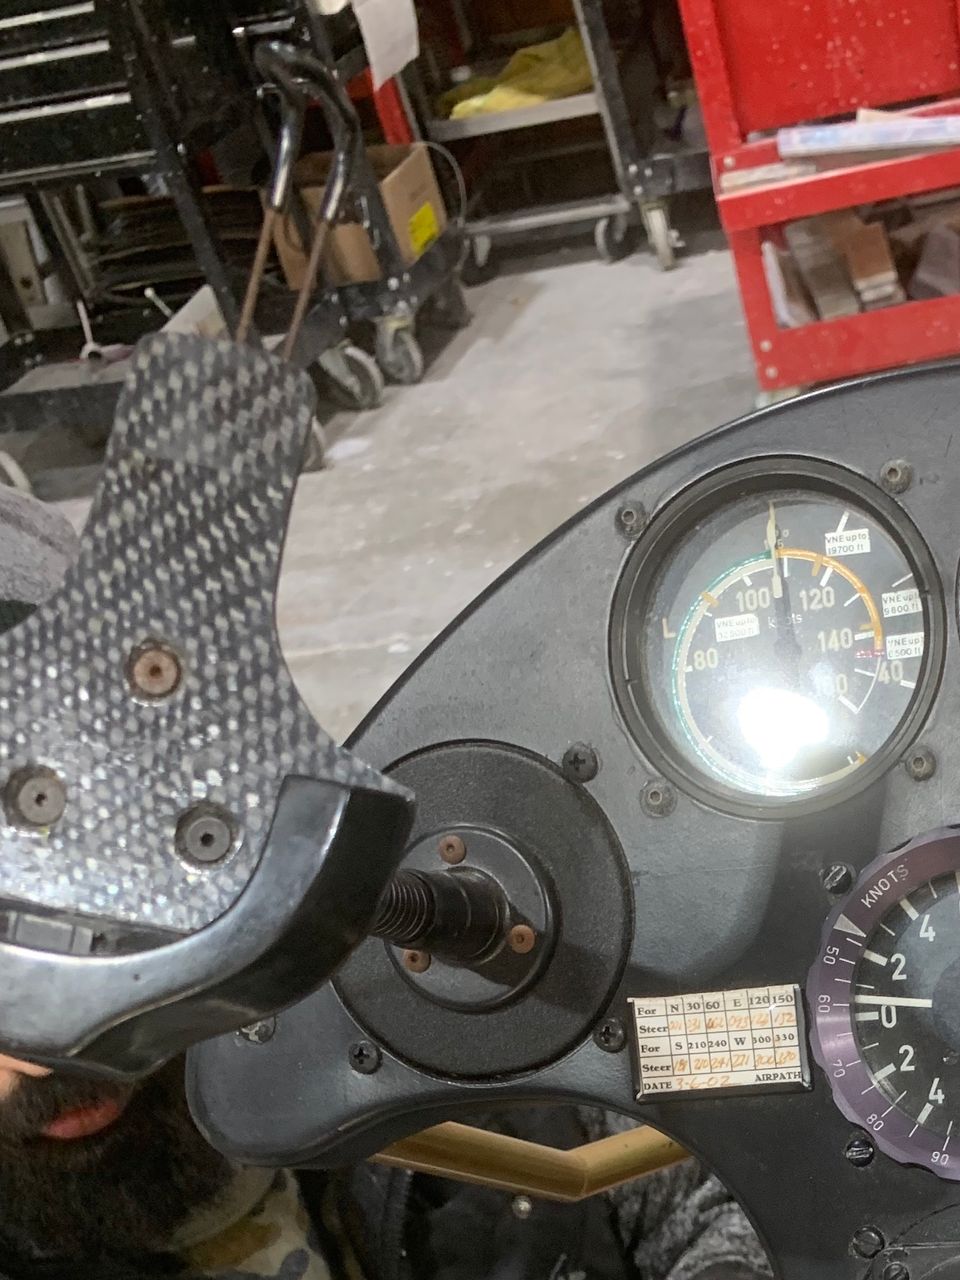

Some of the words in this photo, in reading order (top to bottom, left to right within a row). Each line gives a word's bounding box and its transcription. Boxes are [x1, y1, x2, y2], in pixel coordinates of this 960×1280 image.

[736, 587, 770, 612] 100
[799, 586, 835, 612] 120
[817, 627, 853, 652] 140
[693, 647, 718, 671] 80
[860, 863, 910, 909] KNOTS
[919, 914, 936, 942] 4
[822, 945, 839, 966] 50
[890, 953, 907, 980] 2
[637, 1007, 657, 1016] For
[671, 1003, 680, 1013] N
[686, 1001, 700, 1011] 30
[705, 1001, 720, 1010] 60
[733, 998, 742, 1007] E
[749, 995, 770, 1005] 120
[771, 994, 794, 1004] 150
[818, 994, 831, 1014] 60
[880, 1005, 897, 1029] 0
[639, 1023, 669, 1034] Steer
[640, 1044, 660, 1054] For
[675, 1041, 683, 1051] S
[688, 1041, 707, 1050] 210
[708, 1039, 727, 1048] 240
[734, 1037, 747, 1046] W
[752, 1035, 771, 1044] 300
[775, 1033, 795, 1042] 330
[642, 1063, 672, 1073] Steer
[832, 1059, 846, 1078] 70
[899, 1045, 915, 1072] 2
[643, 1081, 673, 1091] DATE
[755, 1071, 802, 1083] AIRPATH
[929, 1077, 945, 1104] 4
[866, 1113, 885, 1131] 80
[931, 1151, 949, 1166] 90
